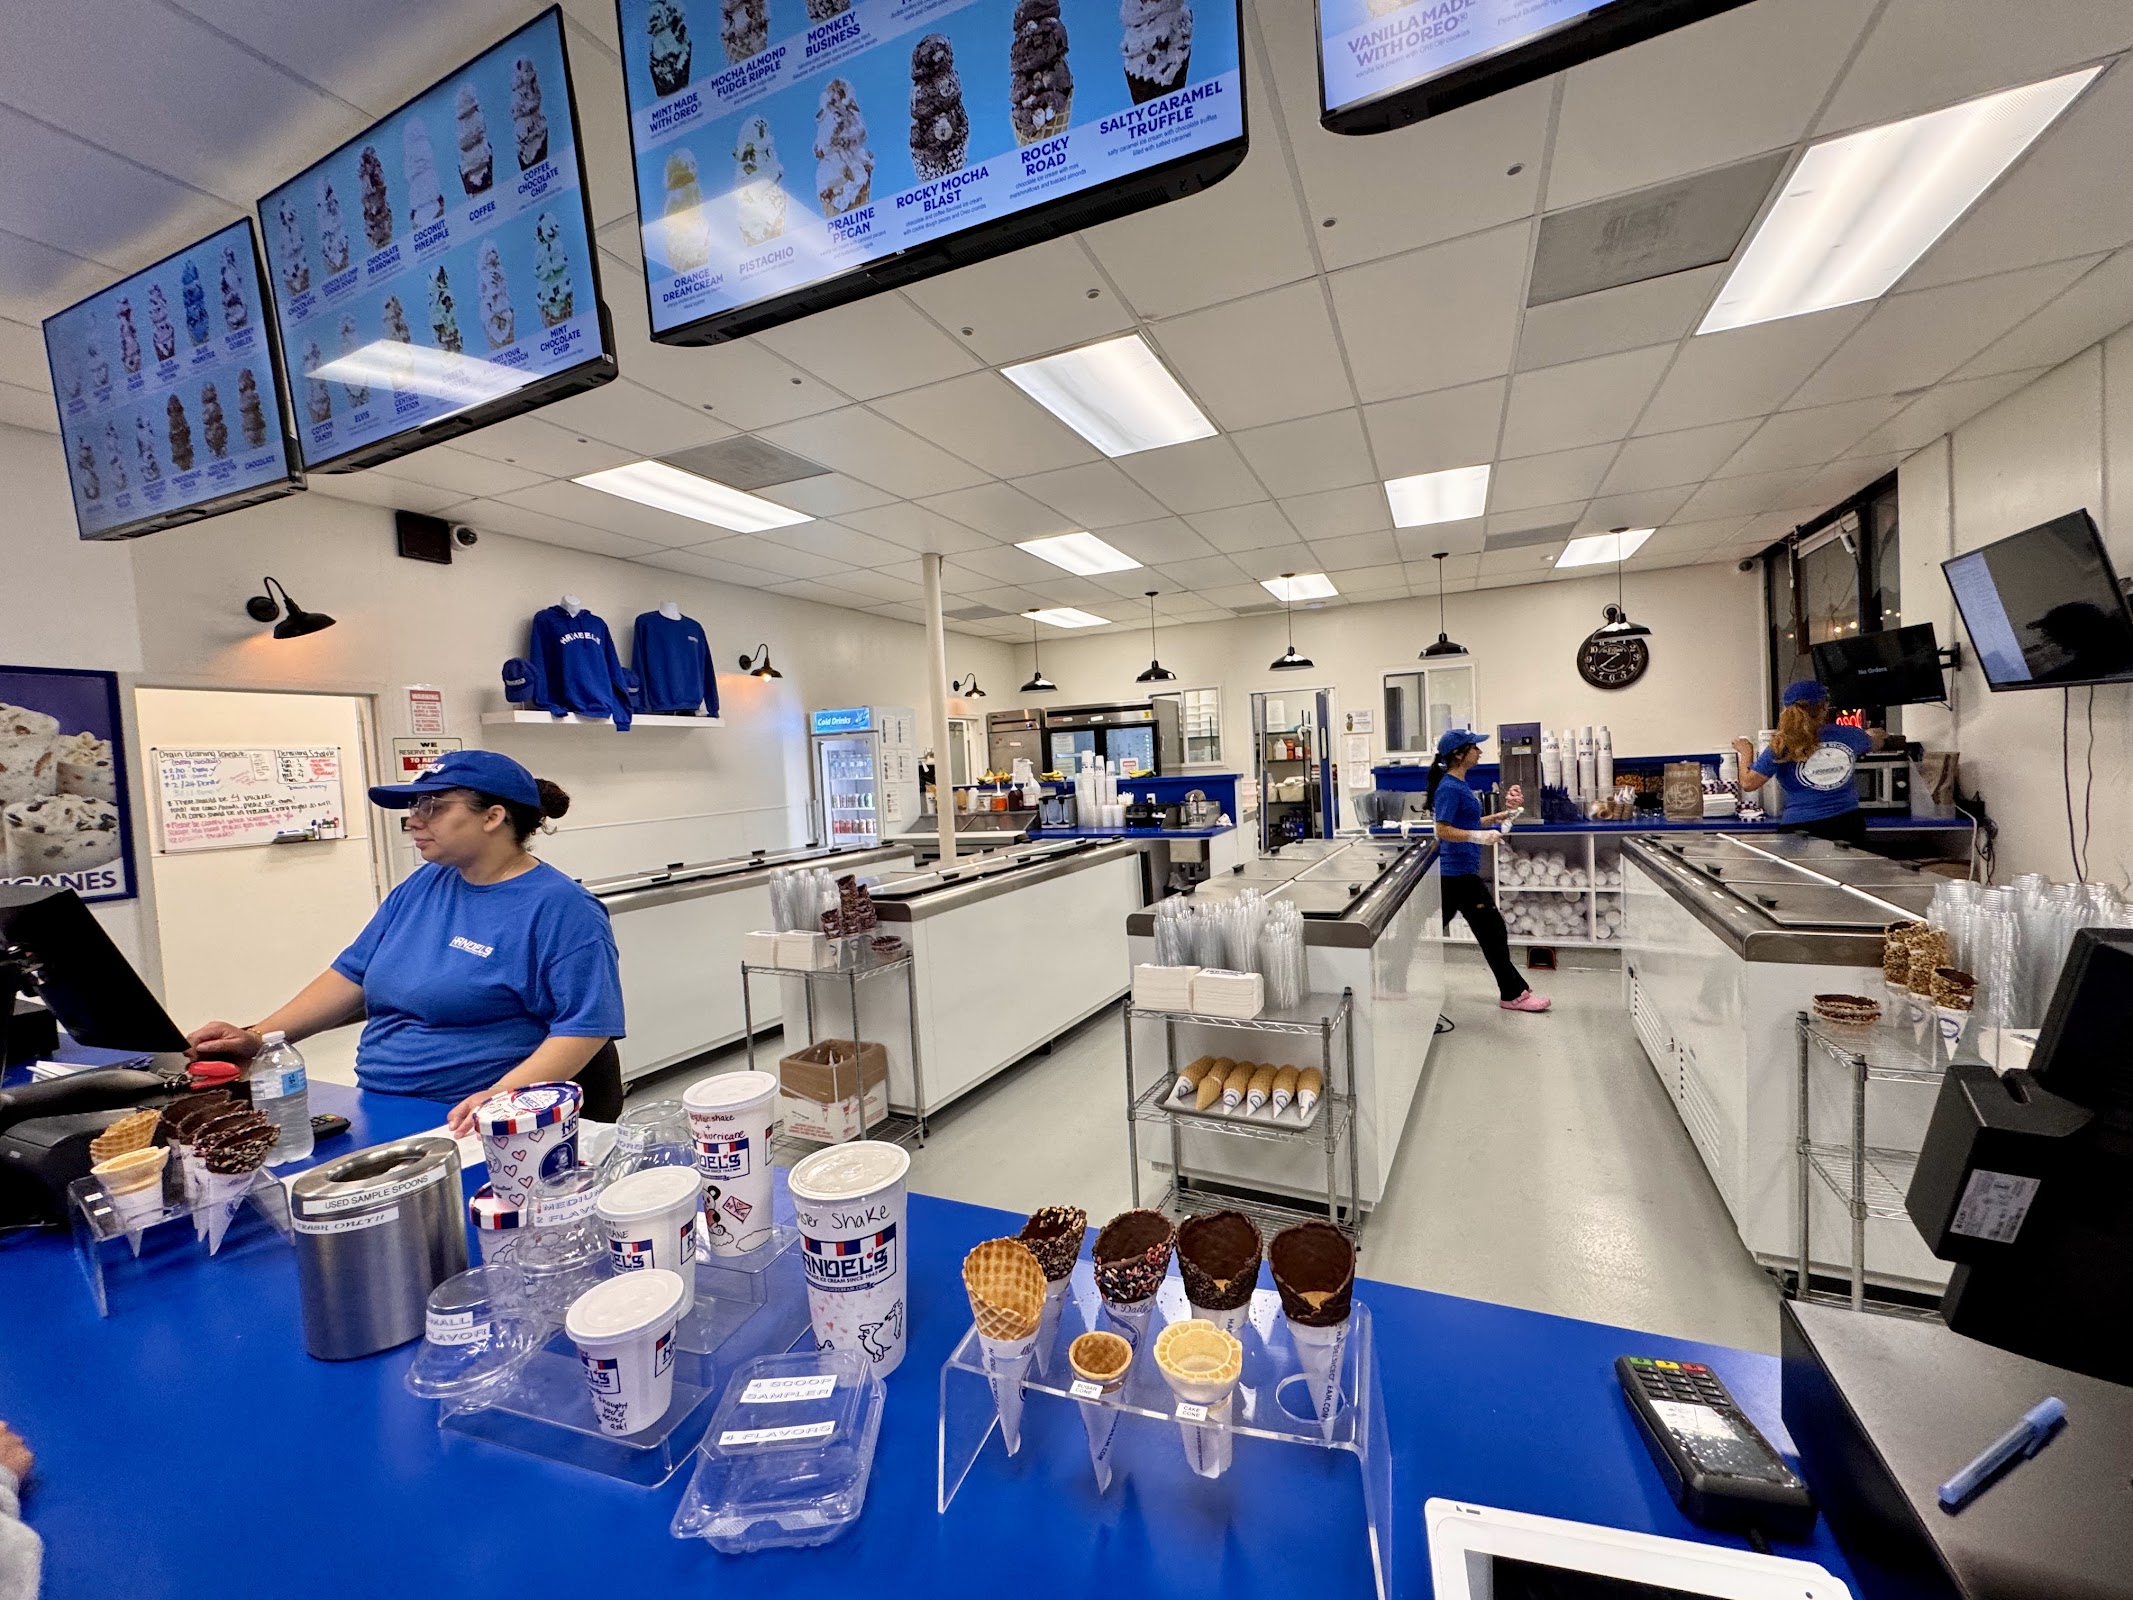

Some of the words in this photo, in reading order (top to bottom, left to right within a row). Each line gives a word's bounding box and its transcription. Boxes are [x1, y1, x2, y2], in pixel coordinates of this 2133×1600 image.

[807, 11, 856, 44] MONKEY
[1348, 16, 1420, 54] VANILLA
[805, 23, 860, 58] BUSINESS
[1356, 38, 1404, 67] WITH
[711, 66, 745, 90] MOCHA
[746, 46, 786, 73] ALMOND
[717, 76, 748, 97] FUDGE
[749, 60, 781, 83] RIPPLE
[652, 104, 673, 122] MINT
[673, 92, 698, 111] MADE
[1100, 108, 1145, 135] SALTY
[1147, 81, 1223, 118] CARAMEL
[649, 116, 673, 132] WITH
[1128, 105, 1194, 140] TRUFFLE
[1021, 136, 1070, 164] ROCKY
[523, 161, 551, 182] COFFEE
[1026, 153, 1067, 176] ROAD
[518, 166, 559, 195] CHOCOLATE
[530, 182, 549, 197] CHIP
[896, 183, 939, 209] ROCKY
[941, 166, 989, 193] MOCHA
[469, 200, 497, 222] COFFEE
[923, 189, 962, 213] BLAST
[414, 219, 447, 243] COCONUT
[827, 206, 875, 234] PRALINE
[414, 228, 449, 253] PINEAPPLE
[833, 221, 871, 244] PECAN
[367, 245, 399, 267] CHOCOLATE
[739, 246, 794, 275] PISTACHIO
[663, 286, 693, 303] DREAM
[693, 273, 724, 292] CREAM
[674, 268, 711, 289] ORANGE
[540, 329, 581, 352] CHOCOLATE
[550, 324, 567, 338] MINT
[504, 347, 521, 359] YOUR
[508, 351, 529, 366] DOUGH
[553, 343, 570, 356] CHIP
[395, 392, 419, 408] CENTRAL
[396, 401, 420, 414] STATION
[354, 411, 370, 423] ELVIS
[311, 421, 334, 436] COTTON
[314, 431, 333, 443] CANDY
[245, 455, 275, 470] CHOCOLATE
[867, 666, 888, 674] Orders
[817, 718, 831, 726] Cold
[831, 717, 852, 725] Drinks
[325, 1198, 350, 1210] USED
[351, 1188, 391, 1206] SAMPLE
[392, 1175, 430, 1194] SPOONS
[847, 1275, 864, 1283] SINCE
[770, 1377, 833, 1388] SCOOP
[1077, 1383, 1099, 1392] SUGAR
[745, 1389, 829, 1400] SAMPLER
[1183, 1405, 1202, 1413] CAKE
[742, 1424, 832, 1441] FLAVORS
